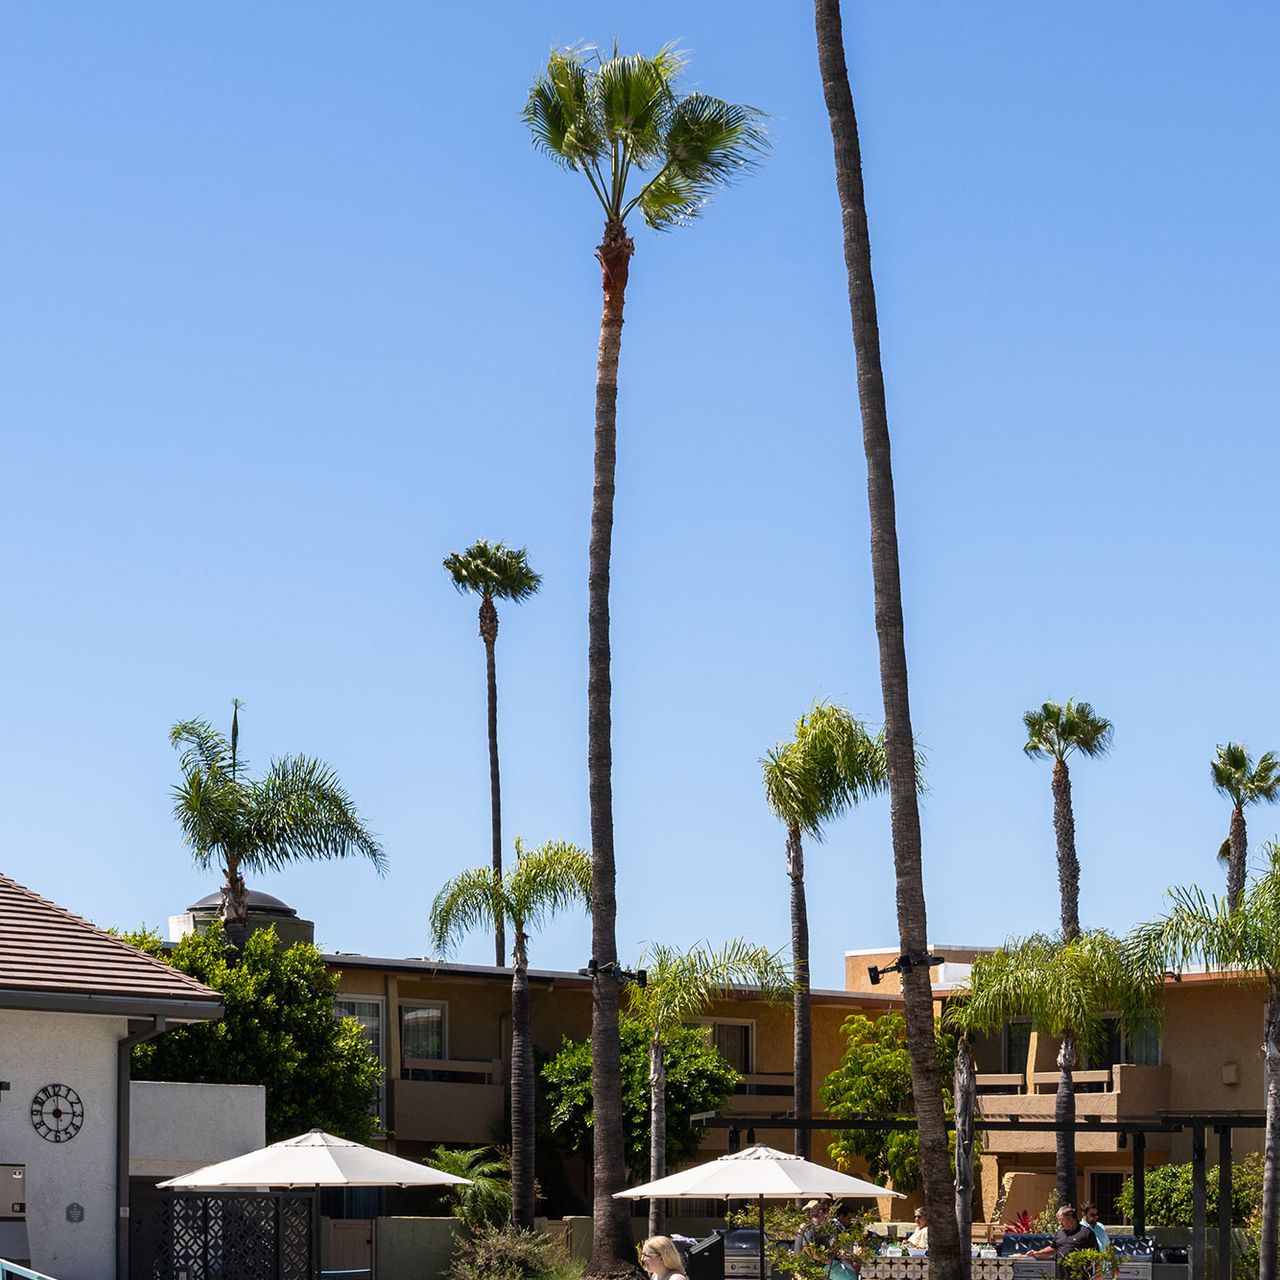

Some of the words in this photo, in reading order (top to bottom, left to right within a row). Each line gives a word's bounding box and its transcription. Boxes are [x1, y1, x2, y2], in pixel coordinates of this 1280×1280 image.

[52, 1085, 61, 1096] 12
[73, 1110, 83, 1118] 3
[34, 1120, 45, 1130] 8
[71, 1122, 81, 1131] 4
[54, 1130, 61, 1142] 6
